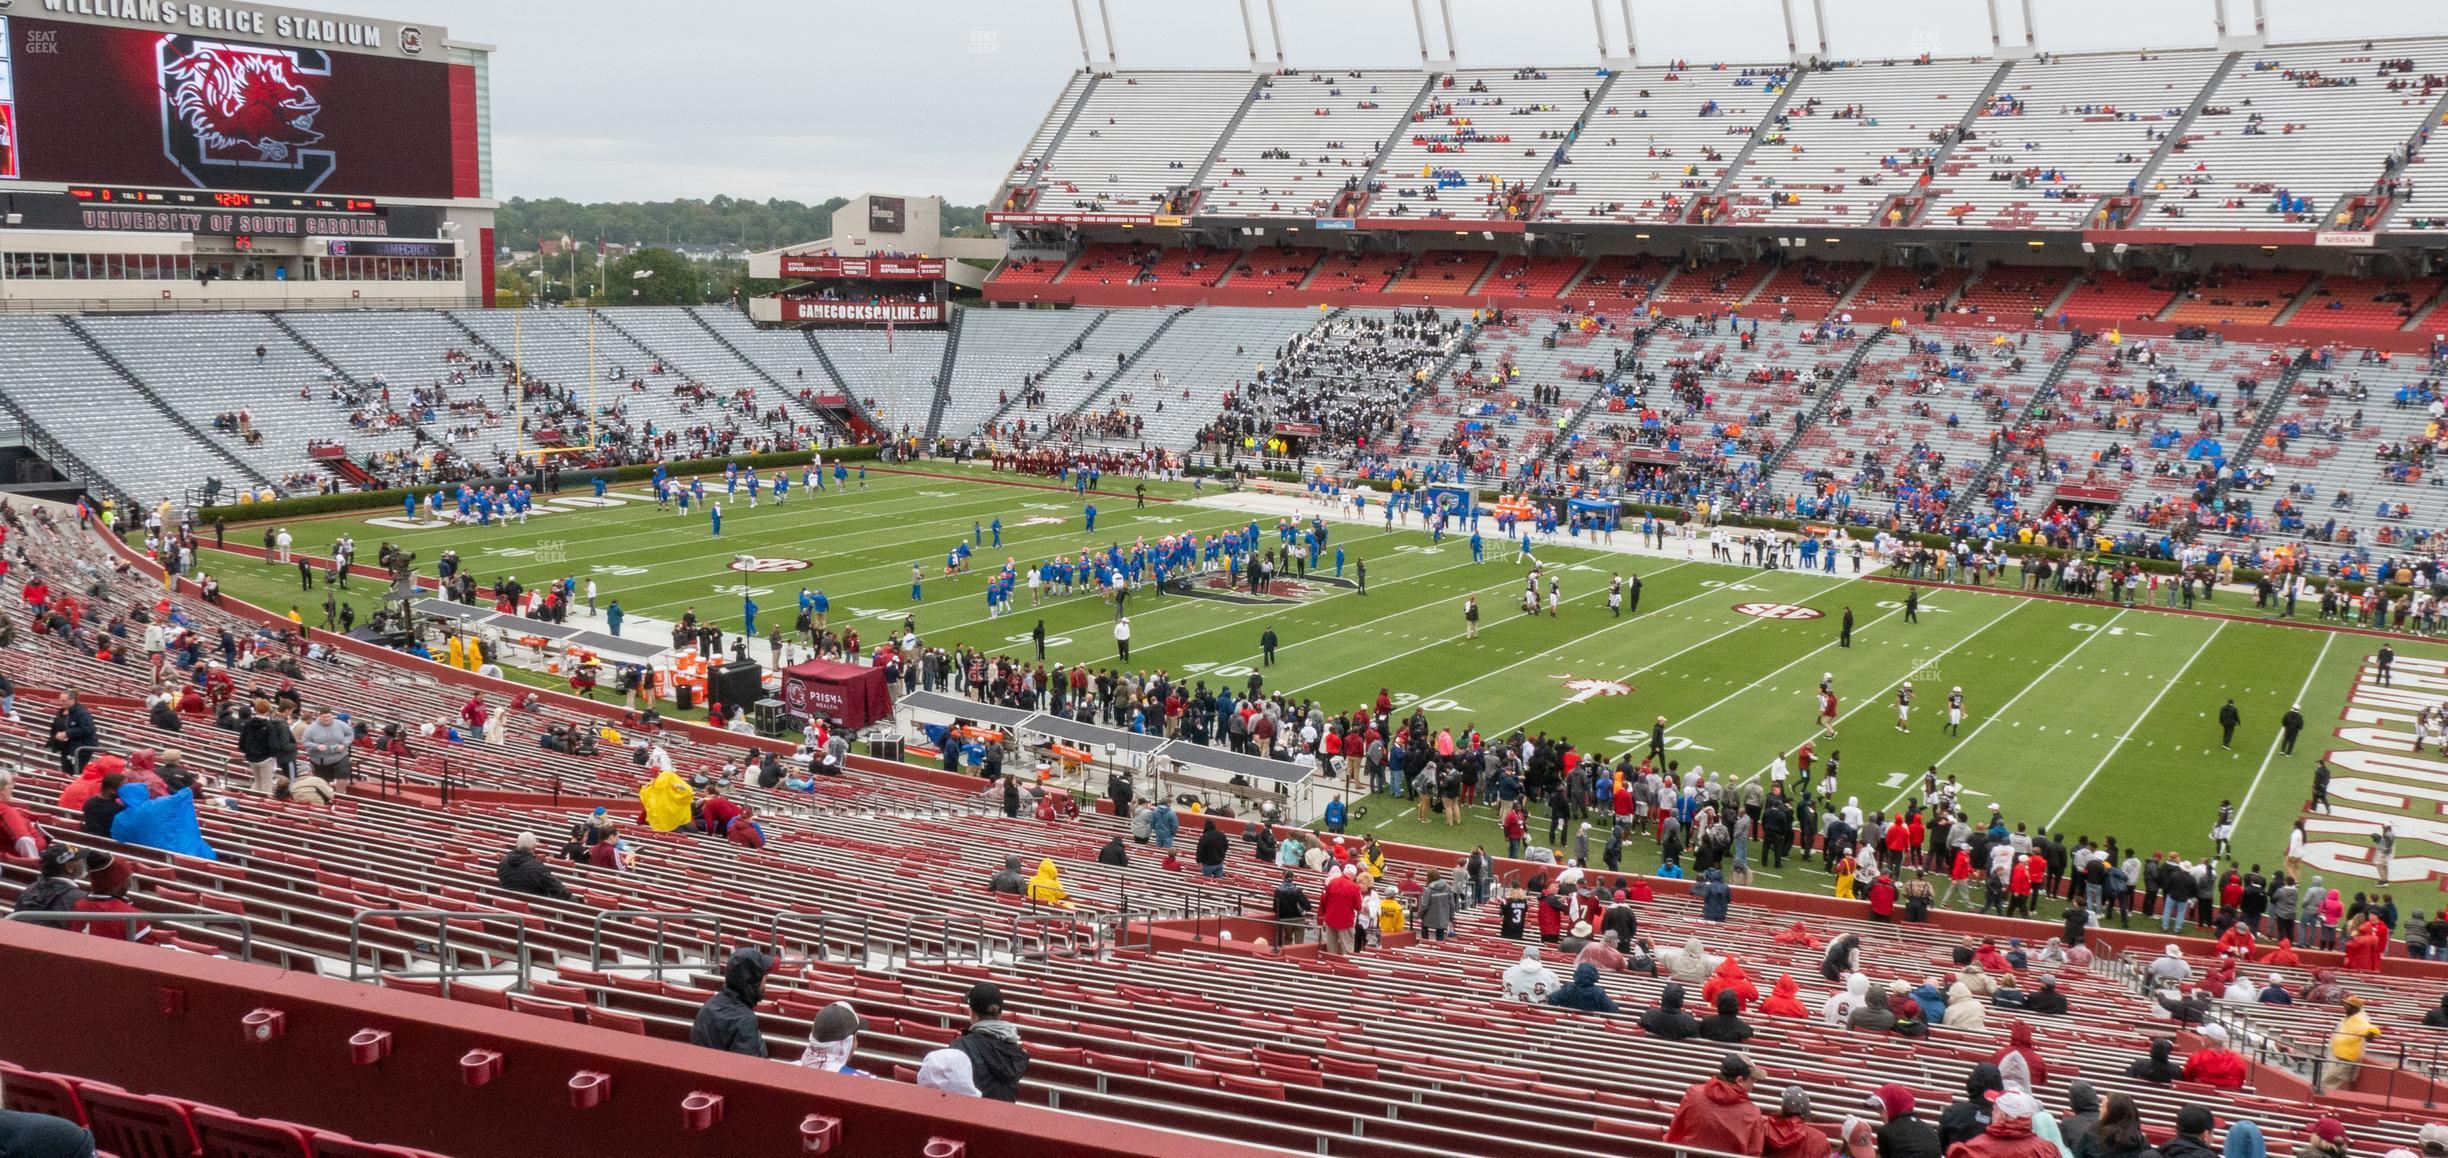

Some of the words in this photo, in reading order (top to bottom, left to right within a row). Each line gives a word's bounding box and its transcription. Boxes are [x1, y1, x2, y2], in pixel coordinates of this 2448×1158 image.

[277, 15, 380, 48] STADIUM
[214, 193, 249, 207] 42:04
[82, 211, 202, 231] UNIVERSITY
[210, 215, 233, 231] OF
[239, 216, 297, 234] SOUTH
[306, 218, 388, 236] CAROLINA
[235, 235, 252, 249] 25
[377, 243, 438, 256] GAMECOCKS
[798, 304, 939, 320] GAMECOCKSONLINE.COM
[1736, 602, 1821, 620] SEC
[809, 691, 843, 705] PRISMA
[815, 702, 838, 711] HEALTH
[1512, 909, 1522, 923] 3
[1580, 904, 1588, 919] 7
